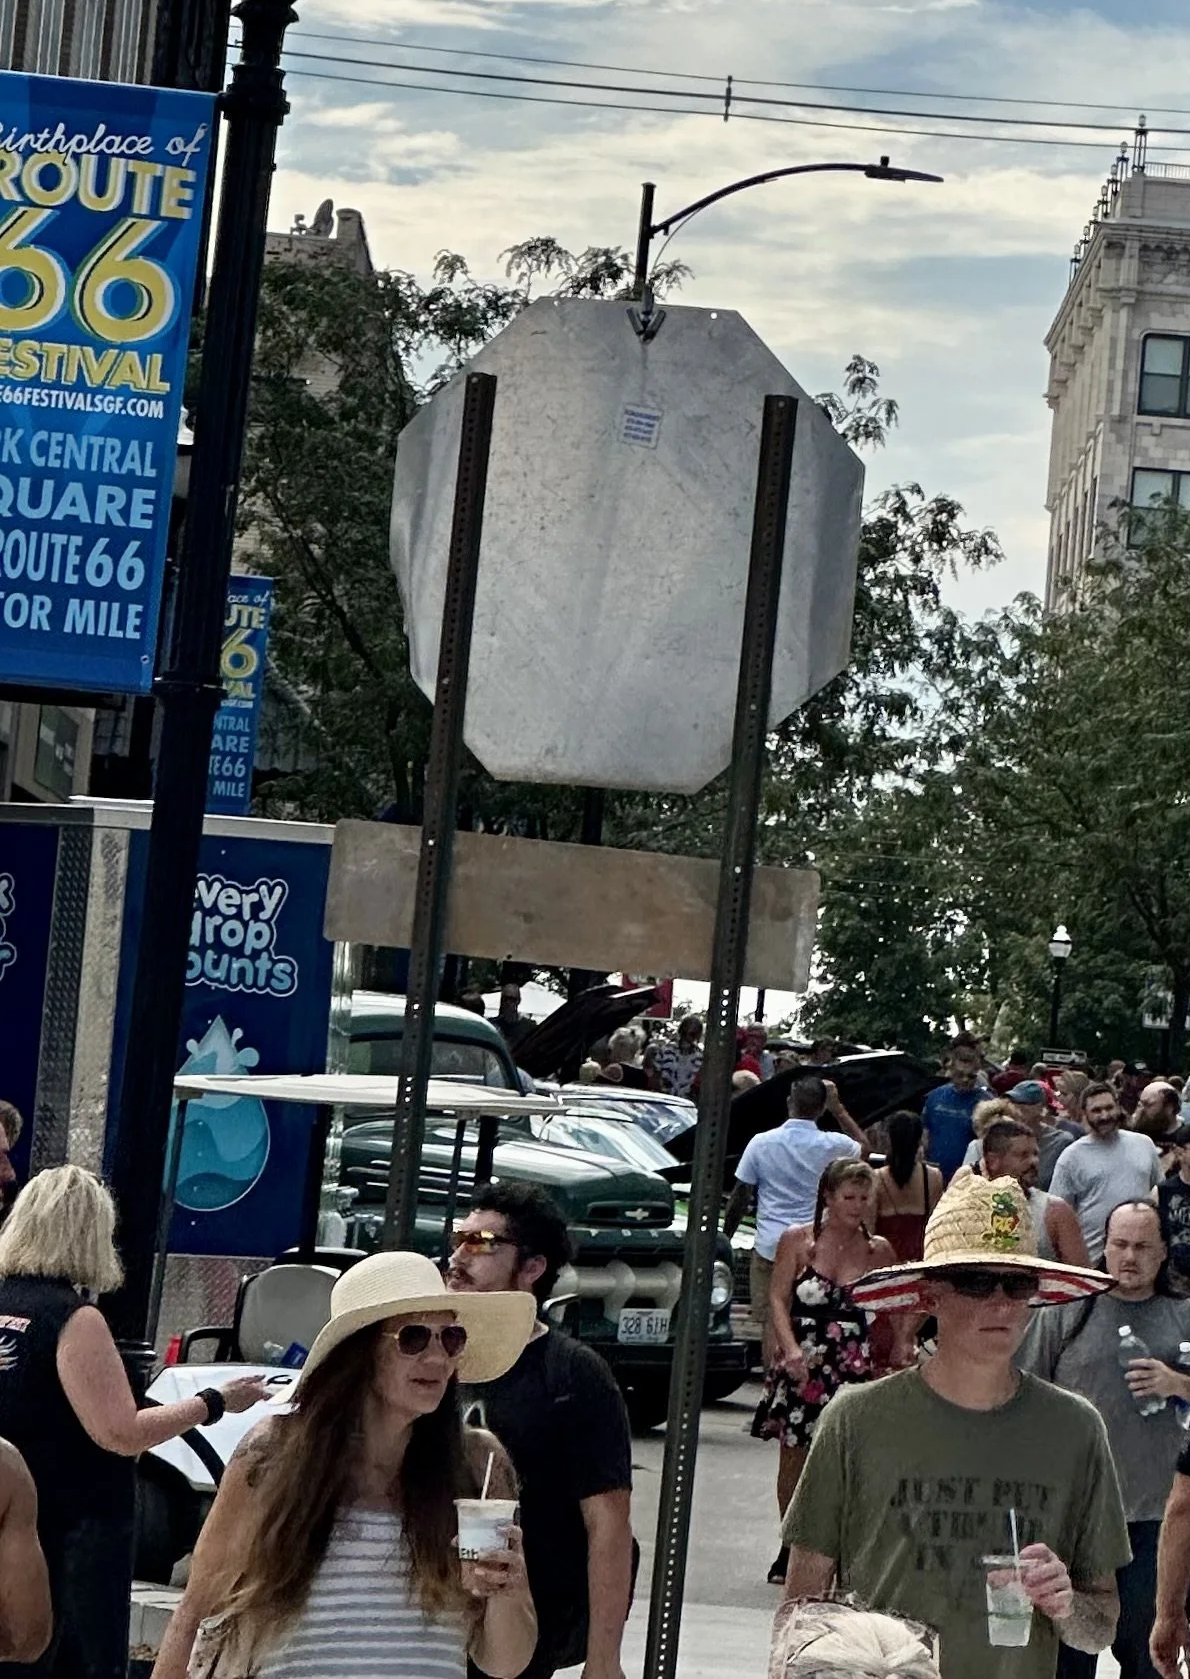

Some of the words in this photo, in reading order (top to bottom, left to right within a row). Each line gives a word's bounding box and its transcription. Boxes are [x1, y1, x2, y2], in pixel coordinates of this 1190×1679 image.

[0, 122, 154, 167] irthplace
[165, 122, 208, 167] of
[0, 205, 179, 344] 66
[0, 337, 171, 395] ESTIVAL
[29, 429, 158, 478] CENTRAL
[0, 528, 83, 585] OUTE
[63, 598, 144, 640] MILE
[210, 732, 251, 754] ARE
[213, 713, 251, 733] NTRAL
[211, 780, 246, 798] MILE
